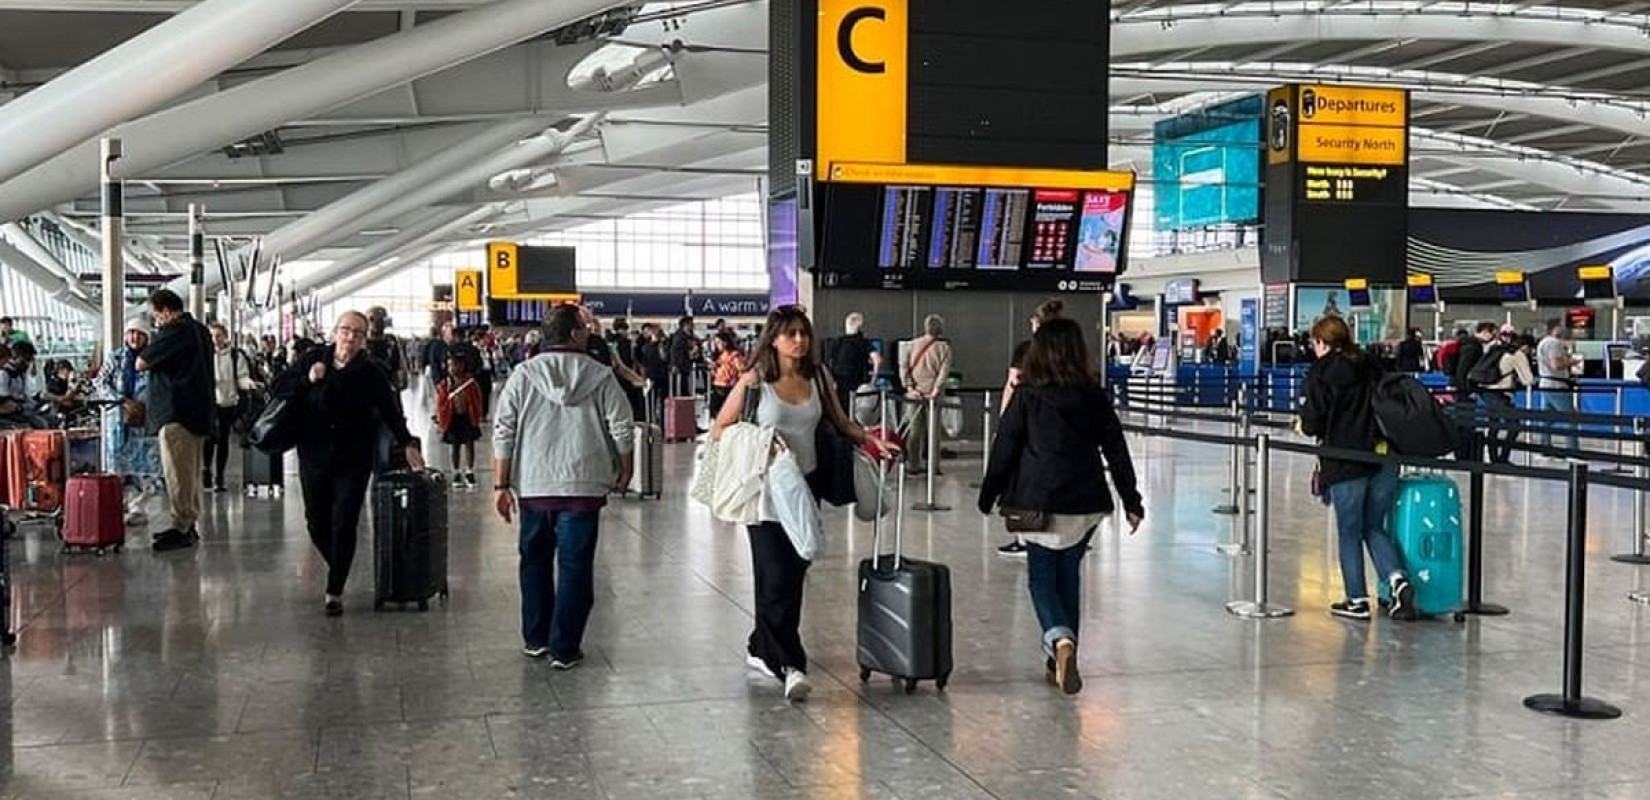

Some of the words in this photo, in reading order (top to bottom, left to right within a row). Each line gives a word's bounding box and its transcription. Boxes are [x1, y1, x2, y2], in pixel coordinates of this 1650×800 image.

[837, 6, 885, 74] C
[1317, 96, 1396, 114] Departures
[1316, 136, 1359, 151] Security
[1363, 138, 1396, 151] North
[497, 251, 510, 269] B
[461, 274, 474, 288] A
[702, 299, 715, 312] A
[718, 301, 756, 312] warm
